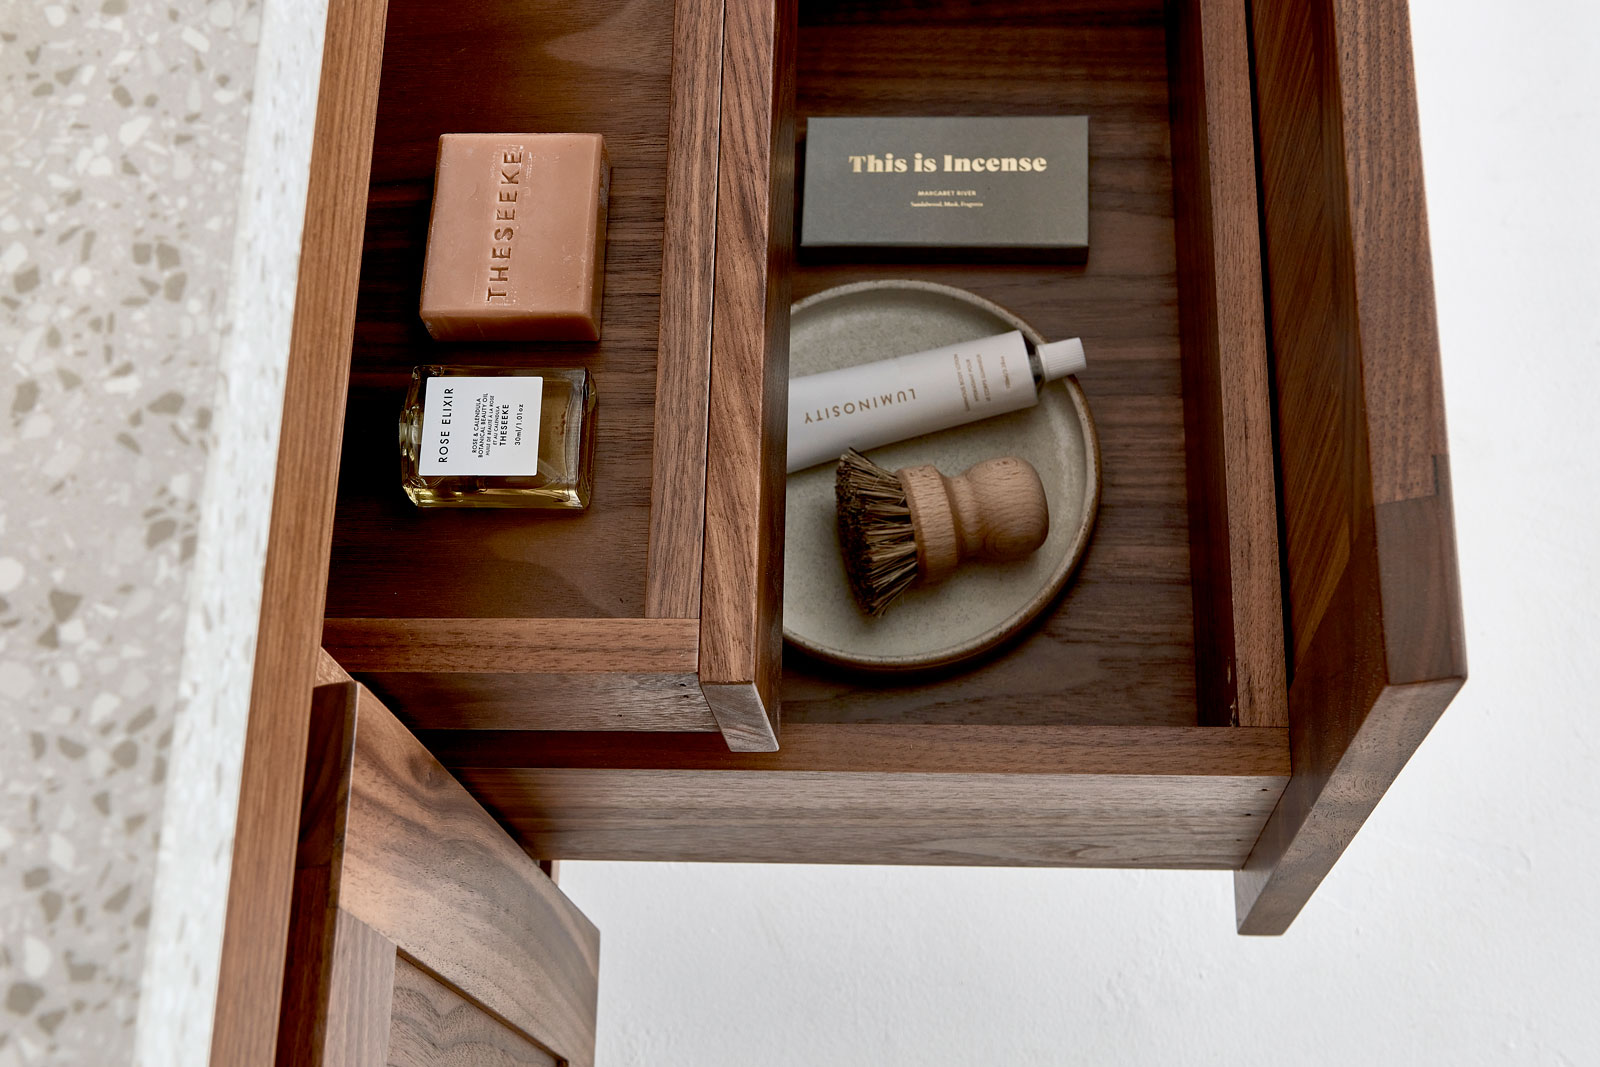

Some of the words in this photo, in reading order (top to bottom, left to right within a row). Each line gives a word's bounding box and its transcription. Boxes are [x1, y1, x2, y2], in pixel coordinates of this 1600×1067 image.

[848, 152, 908, 173] This
[914, 152, 937, 173] is
[943, 154, 1048, 173] Incense
[487, 151, 523, 301] THESEEKE
[441, 388, 454, 424] ELIXIR
[473, 398, 481, 432] CALENDULA
[804, 388, 916, 424] LUMINOSITY
[478, 426, 486, 458] BOTANICAL
[500, 404, 509, 446] THESEEKE
[514, 404, 524, 446] 30ml/1.01oz
[438, 431, 450, 463] ROSE
